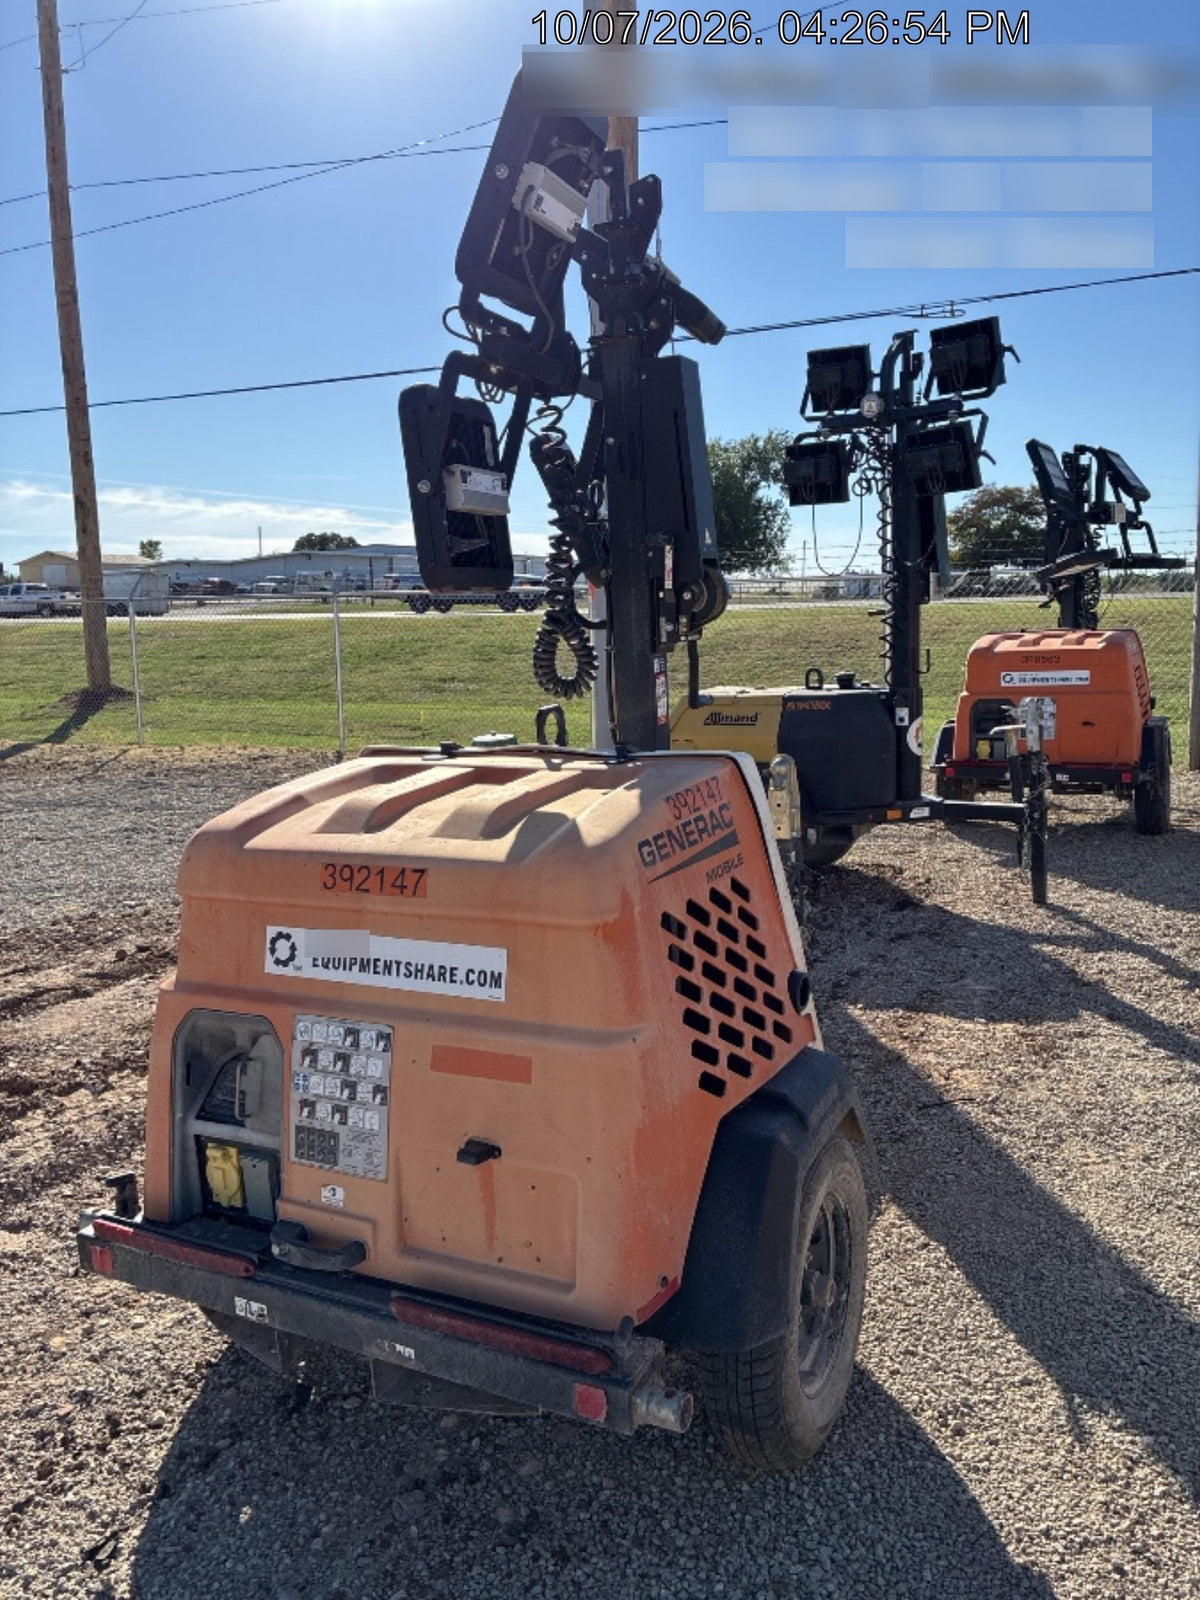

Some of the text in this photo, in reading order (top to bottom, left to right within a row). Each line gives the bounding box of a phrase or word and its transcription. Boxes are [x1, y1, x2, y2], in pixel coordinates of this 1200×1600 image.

[665, 776, 722, 820] 392147
[638, 803, 735, 868] GENERAC
[322, 863, 428, 897] 392147
[705, 853, 744, 883] MOBILE
